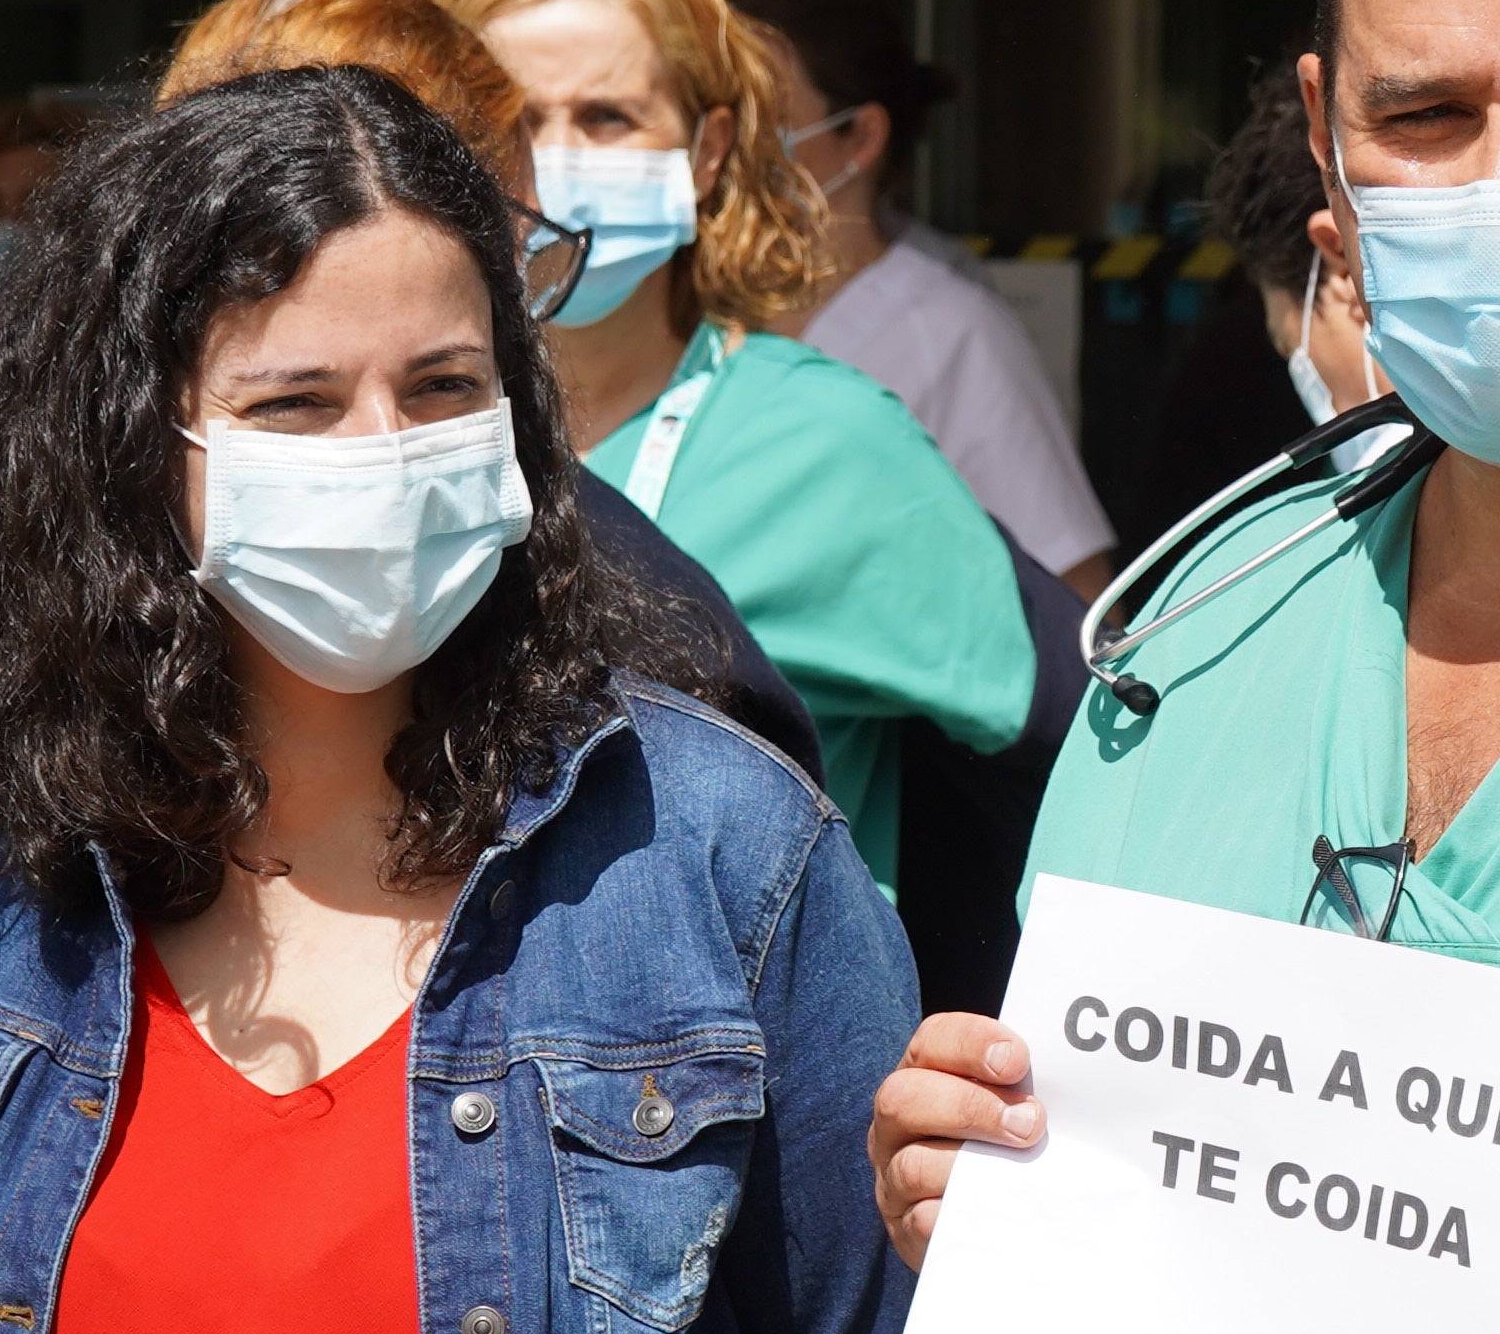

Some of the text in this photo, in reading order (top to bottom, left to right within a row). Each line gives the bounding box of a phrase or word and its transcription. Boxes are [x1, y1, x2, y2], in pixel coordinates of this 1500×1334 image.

[1064, 995, 1293, 1093] COIDA
[1318, 1050, 1368, 1110] A
[1152, 1131, 1470, 1267] TE COIDA
